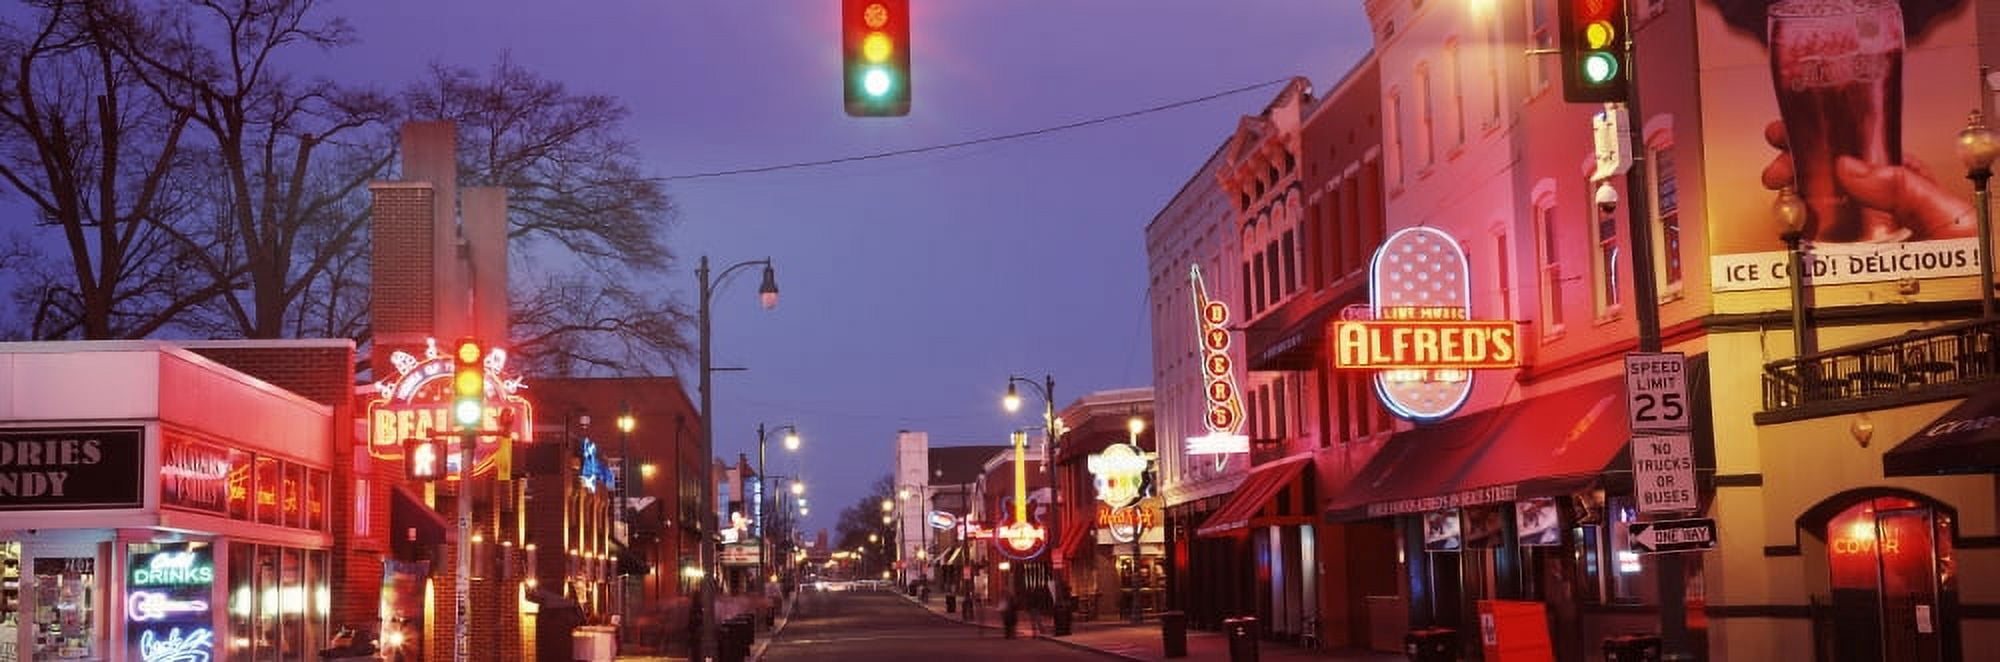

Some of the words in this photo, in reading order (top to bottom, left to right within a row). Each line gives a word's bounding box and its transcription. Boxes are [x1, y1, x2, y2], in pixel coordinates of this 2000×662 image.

[1727, 265, 1759, 282] ICE
[1382, 306, 1416, 320] LIVE
[1420, 306, 1466, 321] MUSIC
[1338, 321, 1514, 365] ALFRED'S
[1631, 361, 1681, 375] SPEED
[1637, 377, 1675, 391] LIMIT
[1635, 393, 1683, 421] 25
[1651, 443, 1671, 455] NO
[1638, 458, 1691, 471] TRUCKS
[1656, 475, 1674, 487] OR
[1645, 490, 1689, 504] BUSES
[1655, 529, 1677, 543] ONE
[1683, 527, 1707, 541] WAY
[133, 566, 214, 585] DRINKS
